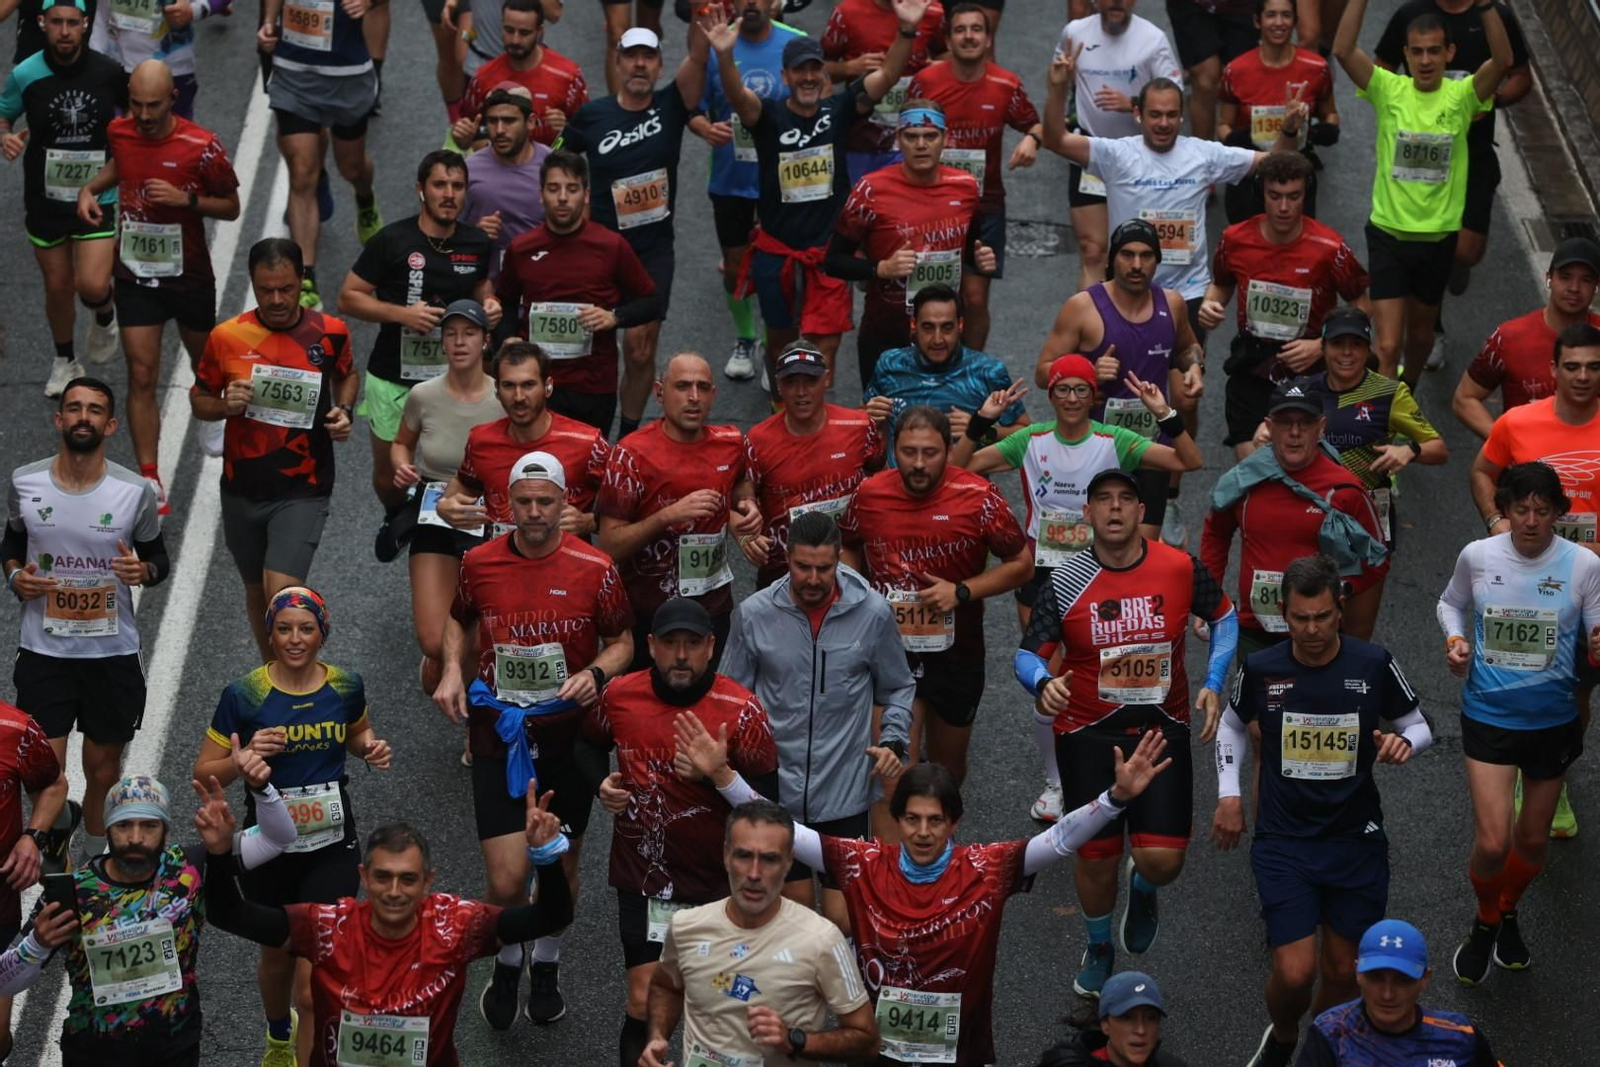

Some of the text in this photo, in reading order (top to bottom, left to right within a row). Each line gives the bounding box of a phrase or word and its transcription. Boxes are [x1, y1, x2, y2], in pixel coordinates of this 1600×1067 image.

[1402, 144, 1438, 161] 8716
[55, 163, 91, 180] 7227
[785, 158, 828, 179] 10644
[623, 182, 659, 207] 4910
[1152, 222, 1185, 242] 594
[131, 235, 166, 254] 7161
[916, 263, 953, 283] 8005
[1252, 295, 1299, 319] 10323
[539, 316, 578, 334] 7580
[412, 340, 448, 357] 757
[261, 379, 303, 403] 7563
[1114, 411, 1153, 429] 7049
[1054, 481, 1076, 489] Naeva
[1054, 488, 1081, 497] running
[1045, 525, 1089, 543] 9835
[56, 590, 102, 611] 6032
[895, 606, 939, 625] 5112
[1090, 613, 1166, 636] RUEDAS
[1091, 631, 1166, 646] Bikes
[1493, 621, 1540, 643] 7162
[506, 660, 551, 681] 9312
[1105, 657, 1150, 676] 5105
[1287, 731, 1349, 755] 15145
[100, 940, 156, 971] 7123
[887, 1005, 940, 1033] 9414
[350, 1030, 407, 1058] 9464
